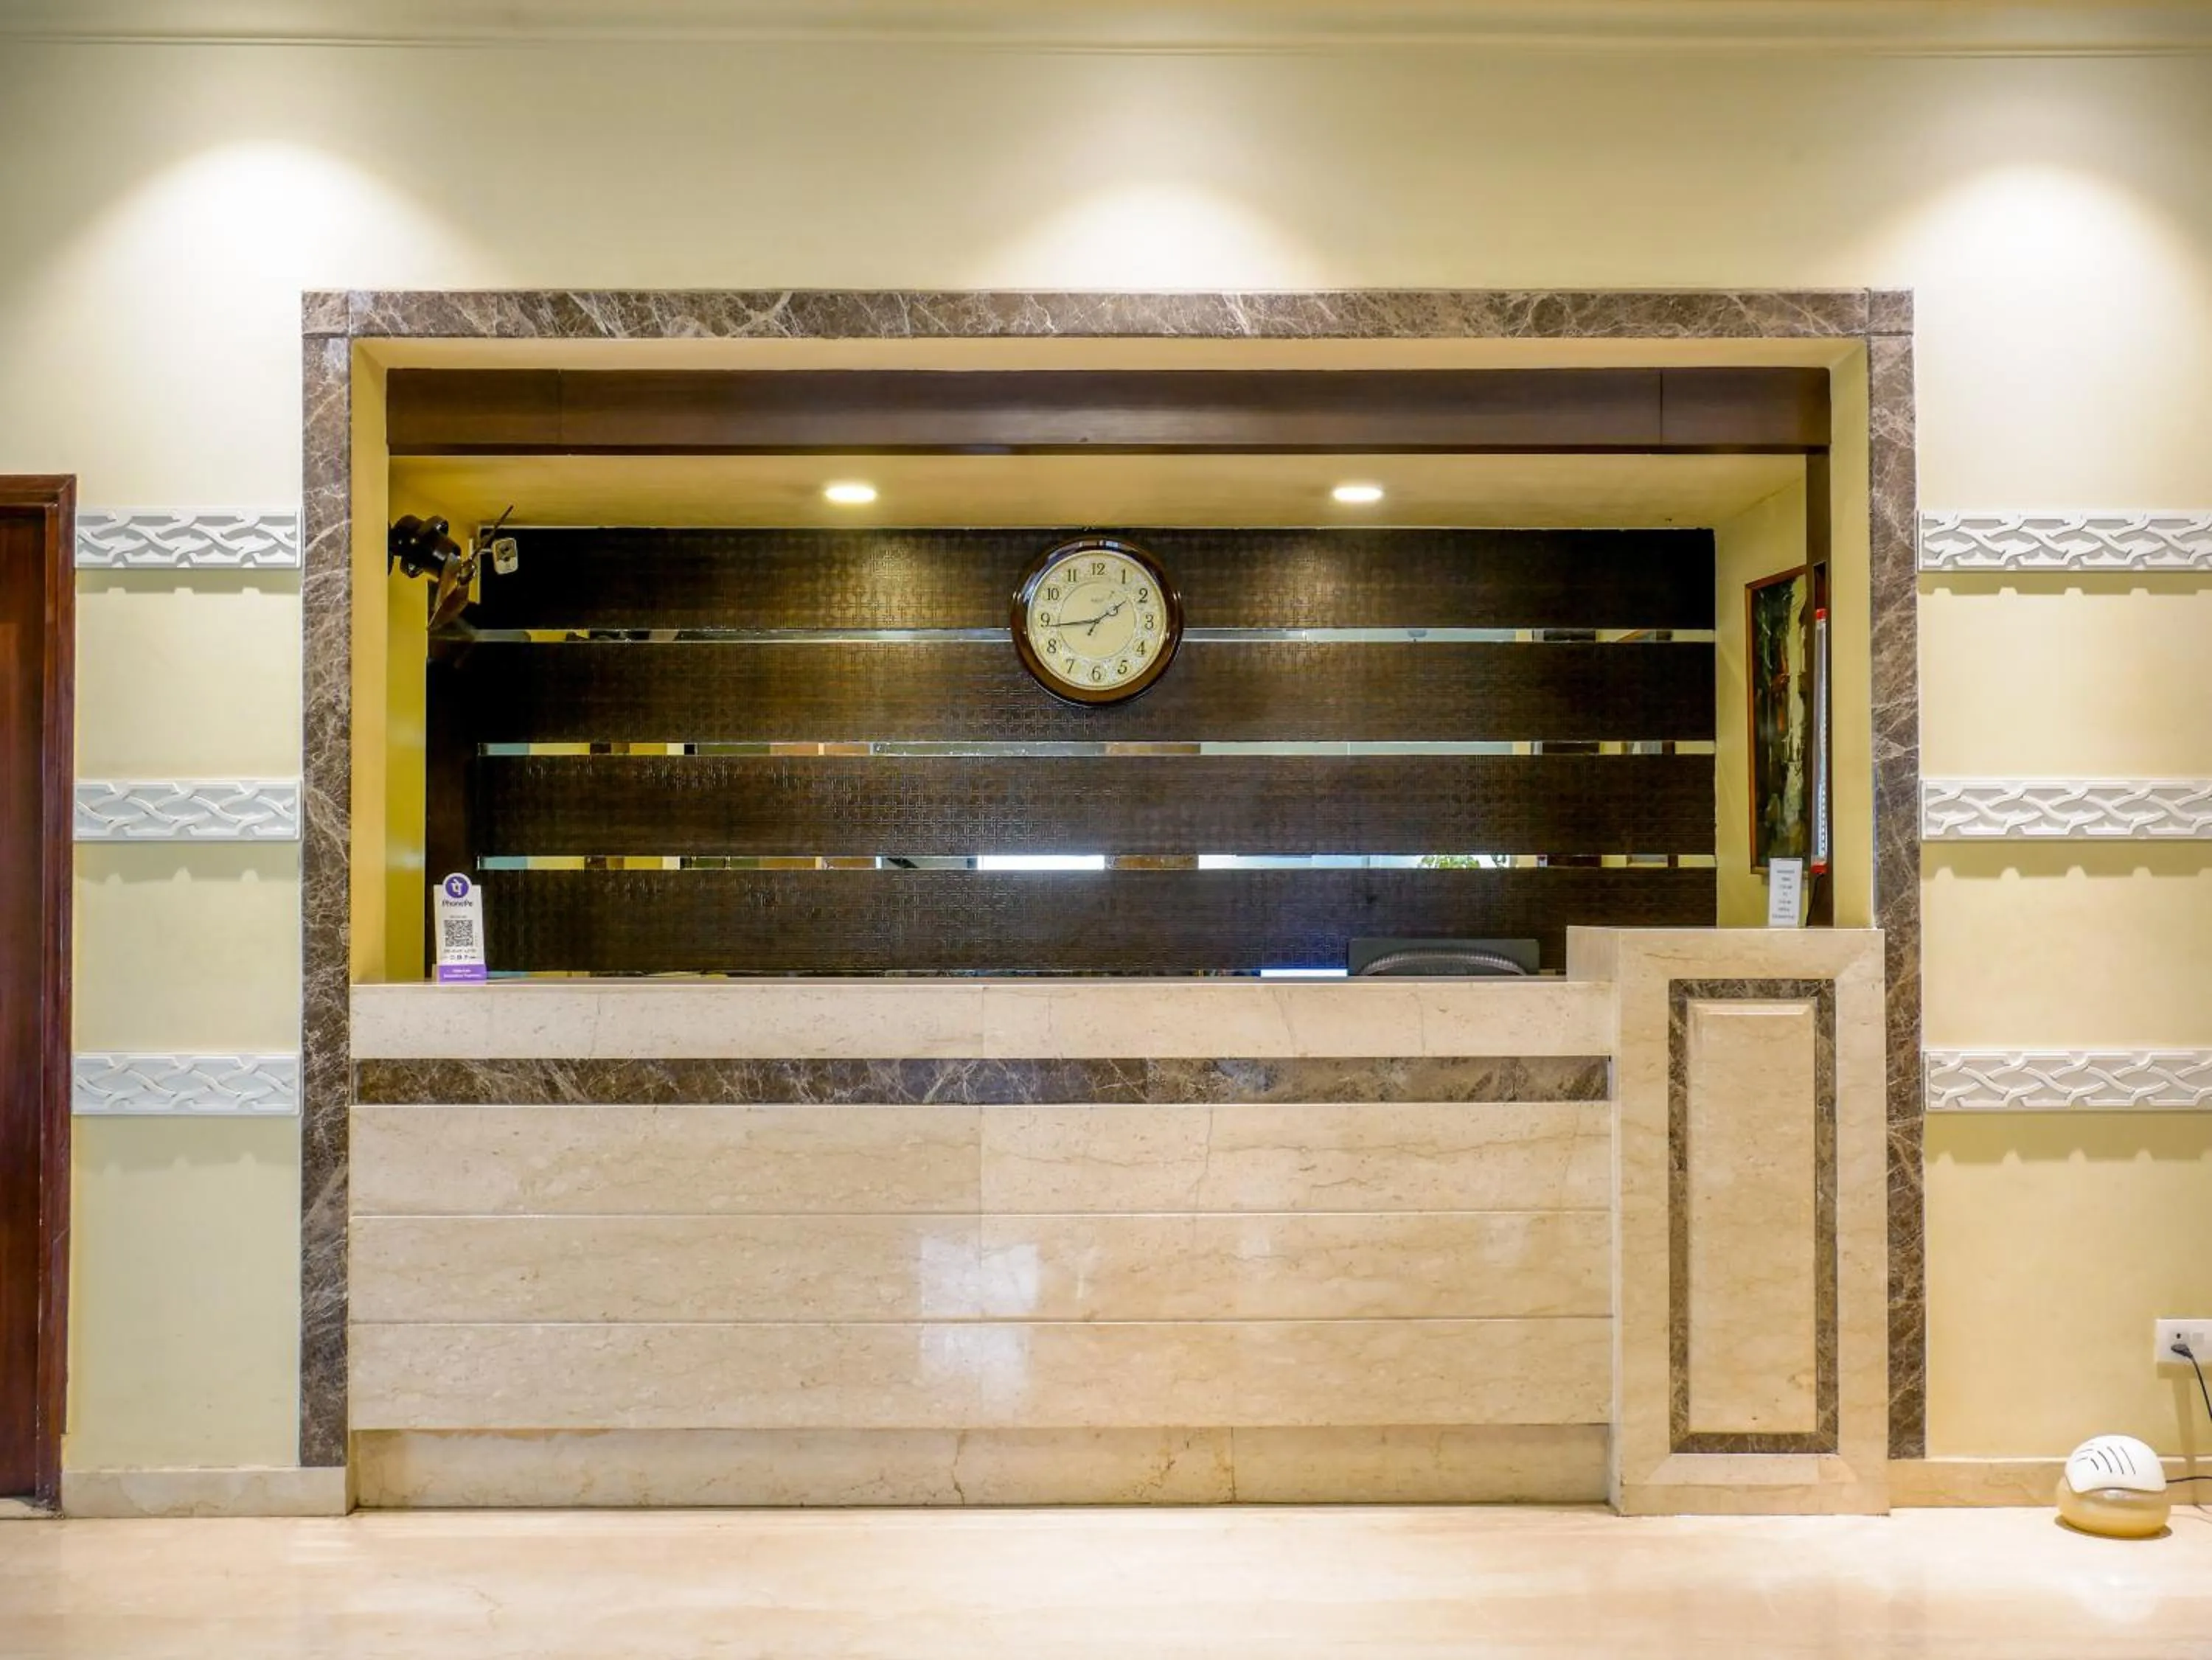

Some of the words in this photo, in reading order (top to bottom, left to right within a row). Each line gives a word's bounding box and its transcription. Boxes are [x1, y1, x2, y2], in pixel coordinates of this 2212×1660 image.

[1067, 569, 1077, 582] 11
[1091, 562, 1106, 576] 12
[1047, 587, 1060, 601] 10
[1138, 587, 1148, 603] 2
[1040, 613, 1051, 627] 9
[1144, 613, 1154, 630] 3
[1046, 639, 1057, 654] 8
[1136, 641, 1146, 655] 4
[1065, 659, 1074, 674] 7
[1092, 666, 1101, 681] 6
[1117, 660, 1128, 674] 5
